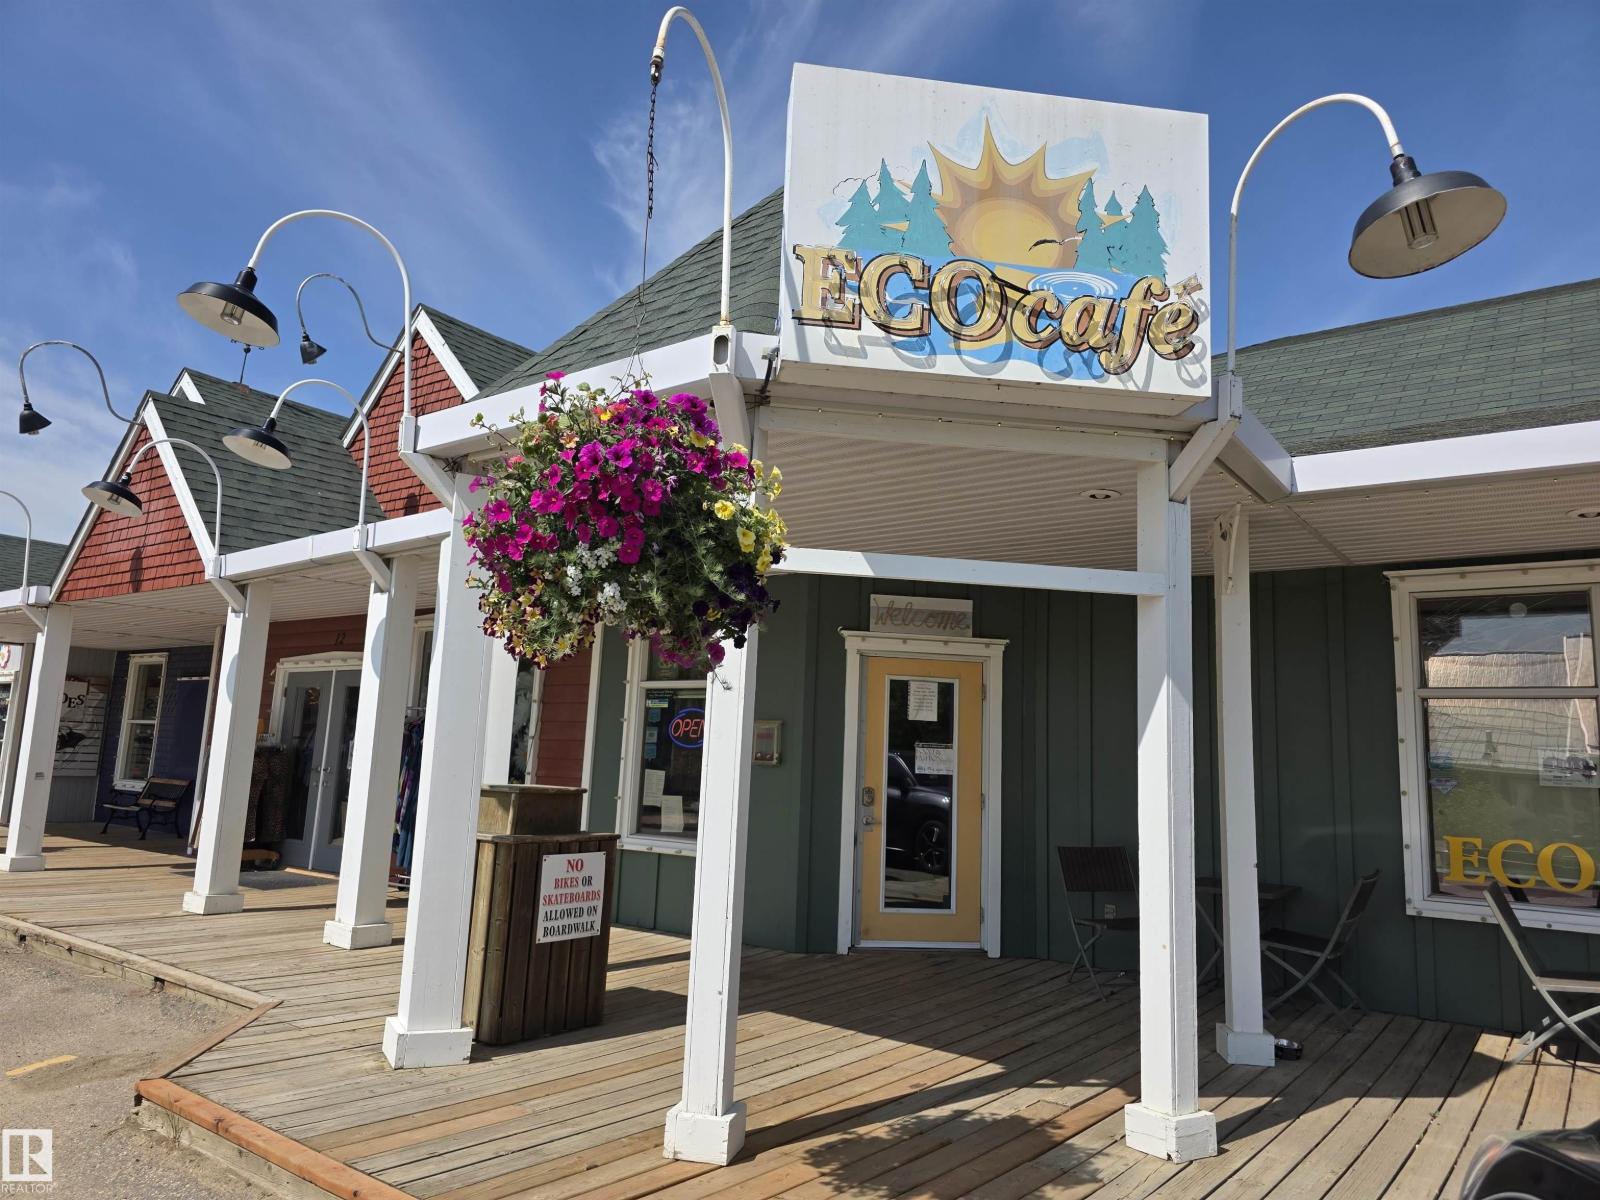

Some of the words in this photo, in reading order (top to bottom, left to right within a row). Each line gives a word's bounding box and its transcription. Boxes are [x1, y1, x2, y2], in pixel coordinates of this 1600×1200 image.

[872, 597, 971, 631] Welcome
[566, 858, 584, 872] NO
[1443, 835, 1596, 893] ECO
[554, 877, 580, 889] BIKES
[581, 875, 593, 887] OR
[542, 890, 601, 906] SKATEBOARDS
[543, 907, 585, 922] ALLOWED
[586, 905, 599, 917] ON
[542, 921, 596, 938] BOARDWALK
